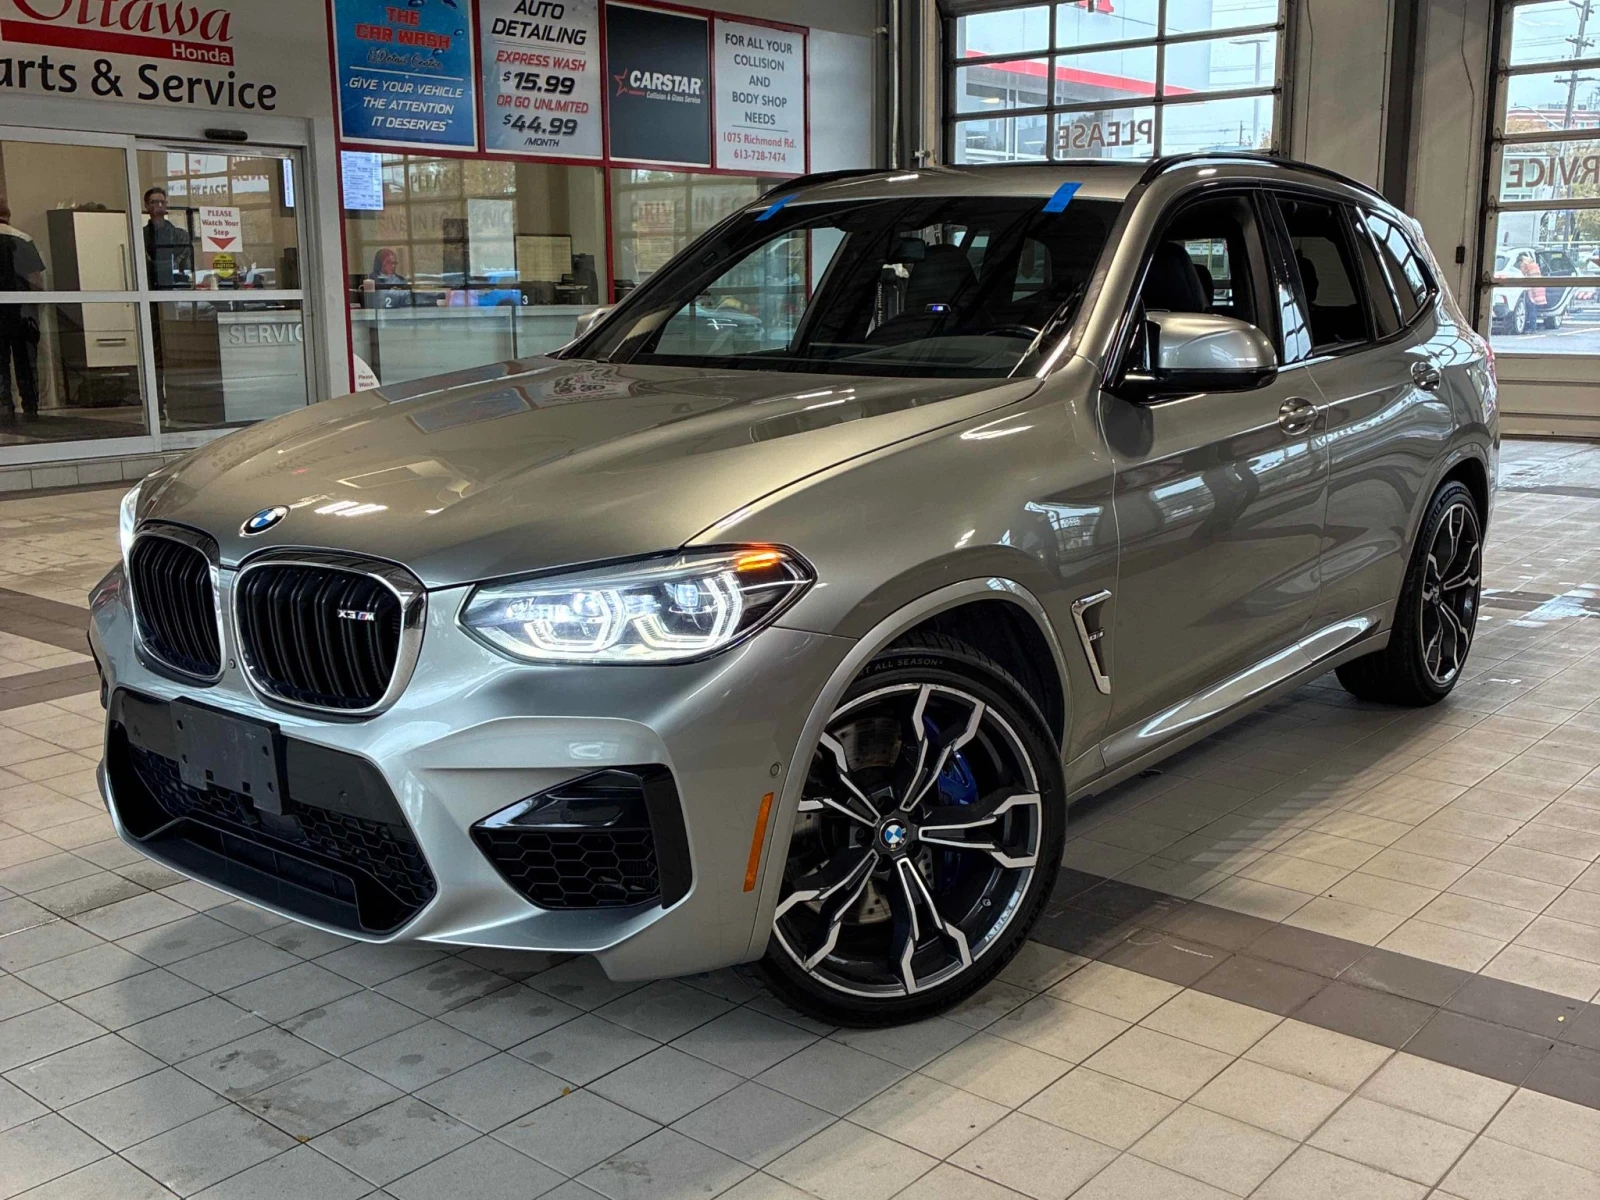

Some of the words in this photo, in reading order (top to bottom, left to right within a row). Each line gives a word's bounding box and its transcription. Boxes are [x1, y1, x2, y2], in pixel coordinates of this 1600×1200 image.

[386, 6, 420, 26] THE
[514, 0, 565, 20] AUTO
[355, 23, 393, 42] CAR
[397, 27, 451, 49] WASH
[491, 19, 587, 46] DETAILING
[171, 42, 231, 64] Honda
[725, 33, 745, 47] FOR
[747, 35, 764, 50] ALL
[766, 39, 793, 55] YOUR
[495, 50, 550, 67] EXPRESS
[552, 57, 587, 72] WASH
[734, 54, 785, 71] COLLISION
[91, 58, 124, 98] &
[137, 63, 277, 111] Service
[348, 77, 378, 91] GIVE
[381, 80, 414, 94] YOUR
[416, 83, 464, 99] VEHICLE
[502, 71, 576, 95] $15.99
[629, 70, 702, 95] CARSTAR
[748, 74, 771, 88] AND
[363, 96, 387, 109] THE
[388, 99, 455, 115] ATTENTION
[496, 94, 513, 107] OR
[514, 96, 530, 109] GO
[534, 97, 589, 114] UNLIMITED
[732, 92, 760, 106] BODY
[761, 95, 788, 109] SHOP
[371, 116, 384, 128] IT
[387, 117, 447, 132] DESERVES
[502, 113, 578, 136] $44.99
[744, 111, 776, 126] NEEDS
[723, 131, 742, 144] 1075
[743, 134, 782, 148] Richmond
[784, 137, 797, 148] Rd.
[734, 148, 786, 162] 613-728-7474
[207, 209, 232, 217] PLEASE
[201, 219, 223, 227] Watch
[213, 229, 230, 237] Step
[227, 300, 234, 311] 1
[385, 297, 393, 308] 2
[522, 295, 529, 305] 3
[874, 662, 894, 672] ALL
[897, 658, 938, 667] SEASON
